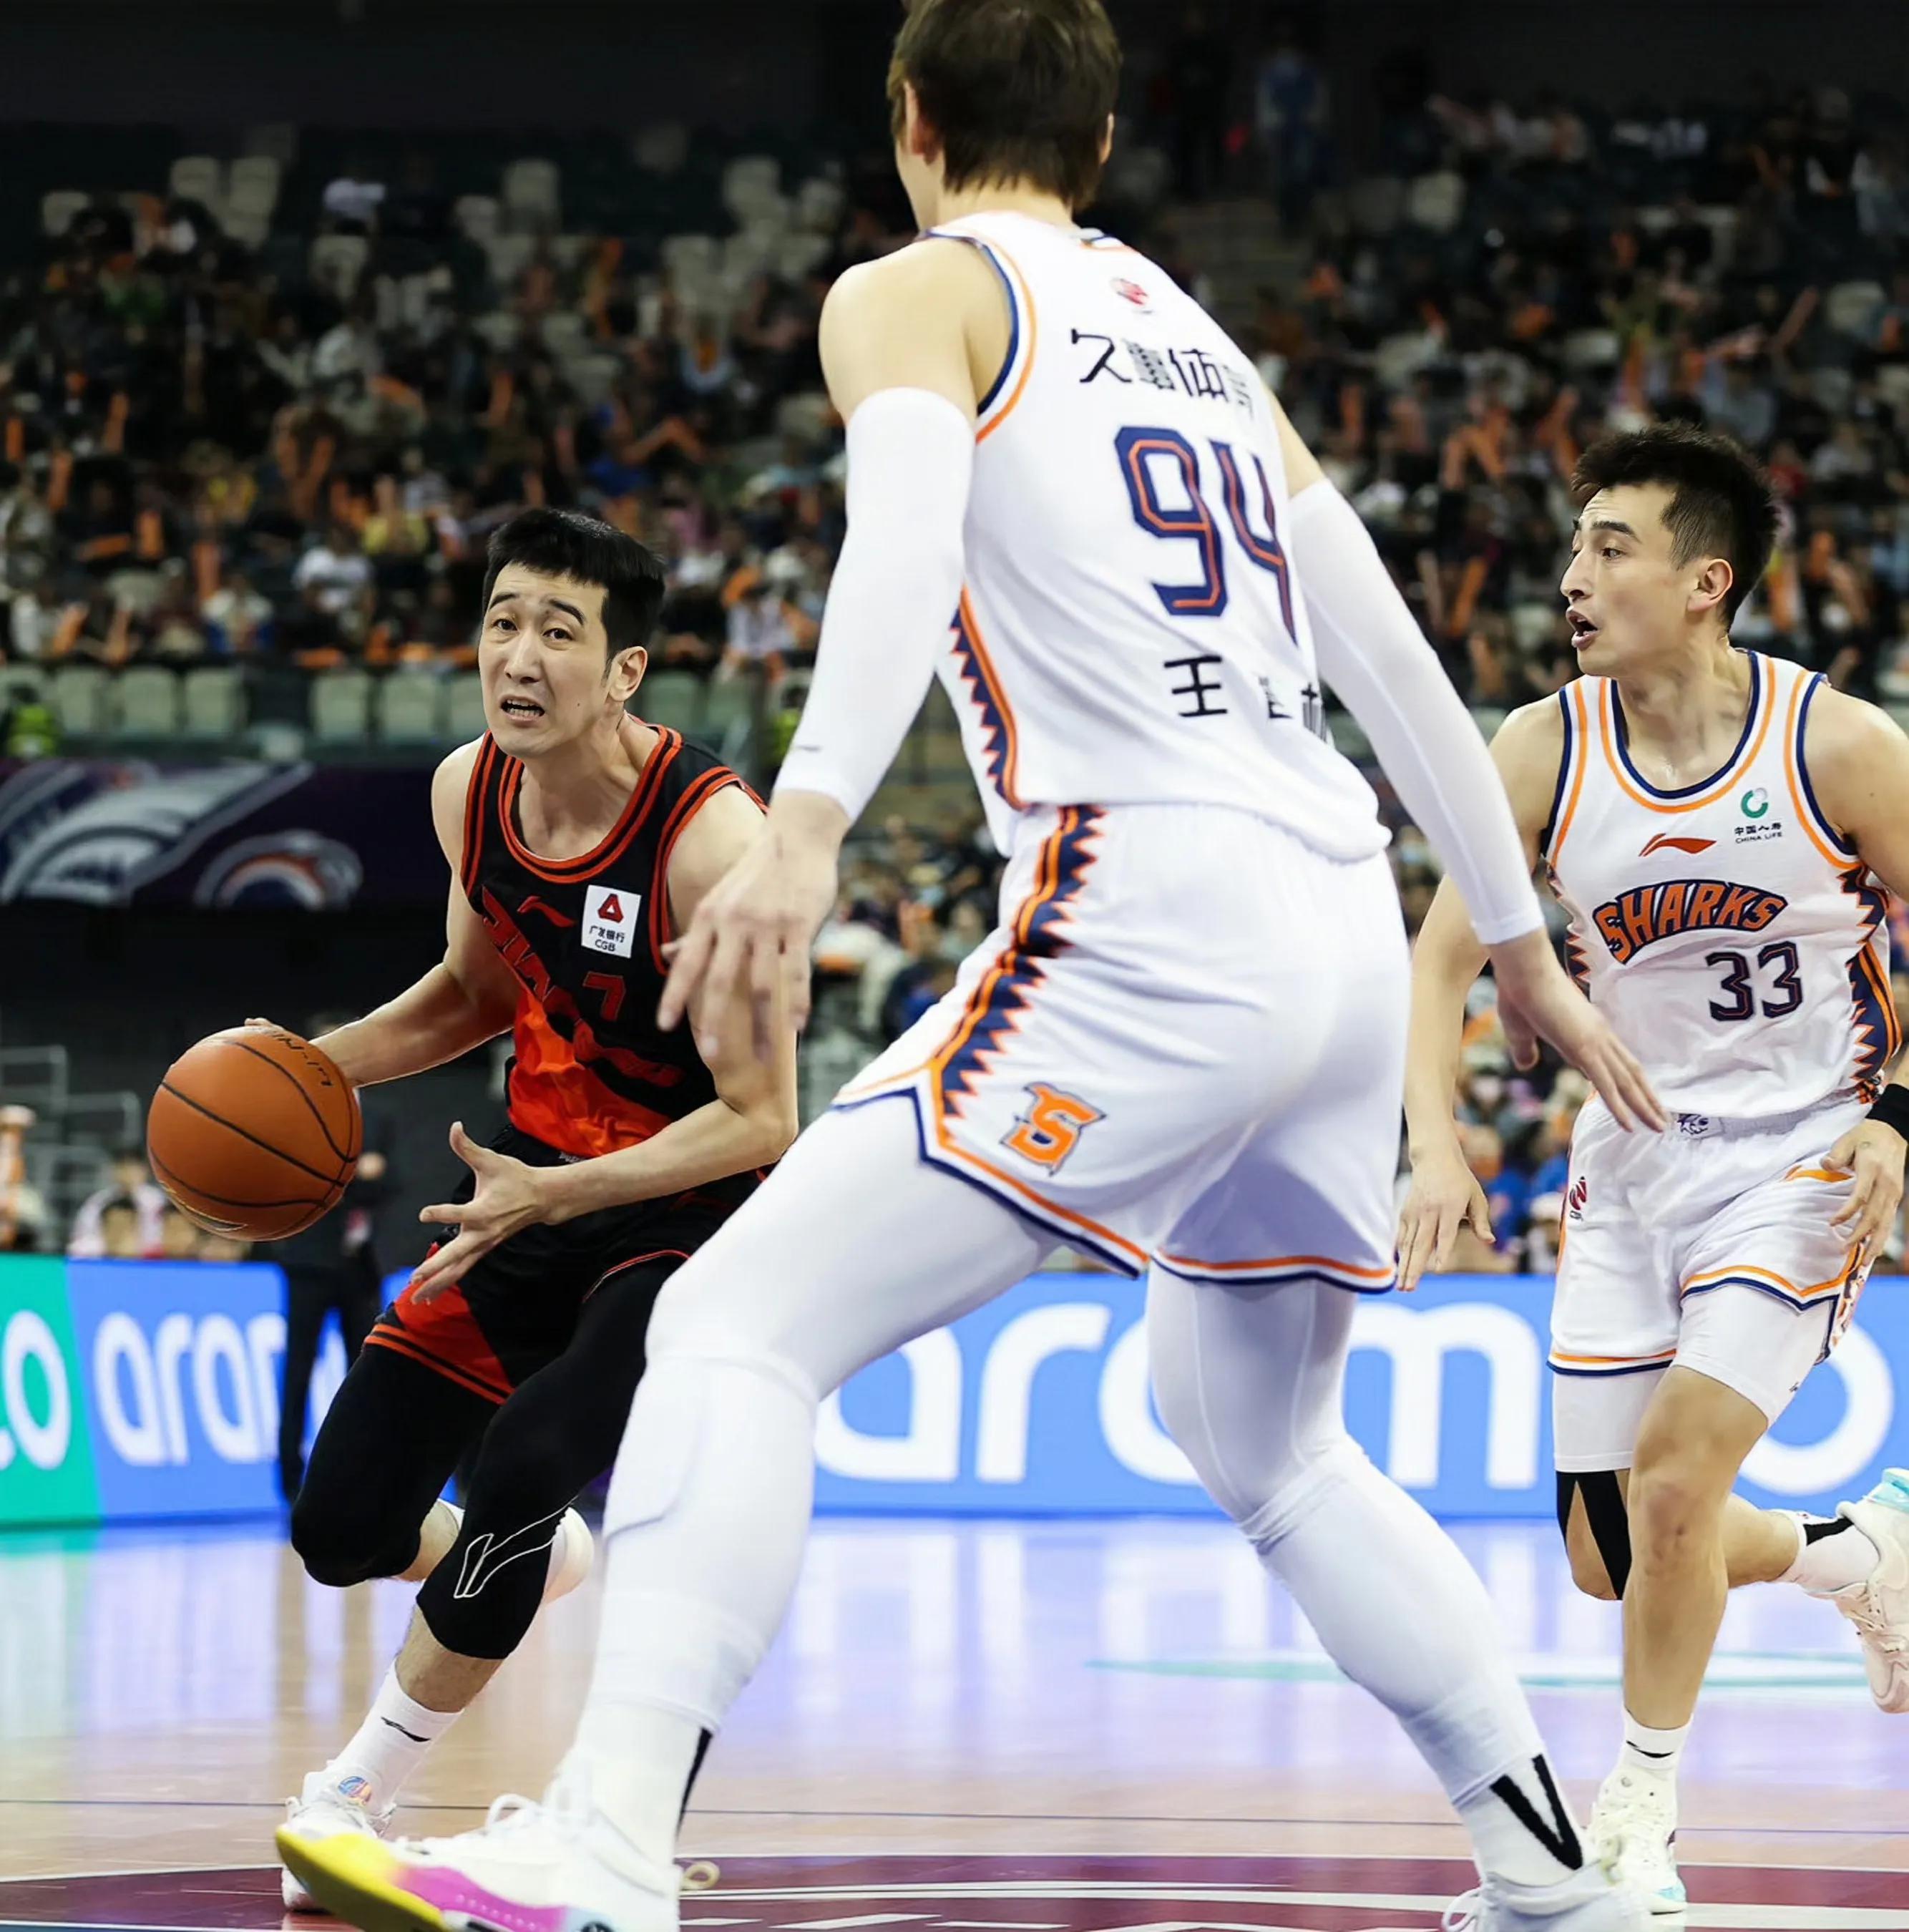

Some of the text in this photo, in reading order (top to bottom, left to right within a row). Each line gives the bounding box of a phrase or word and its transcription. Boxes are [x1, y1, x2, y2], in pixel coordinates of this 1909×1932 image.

[1114, 426, 1300, 648] 94
[595, 939, 615, 952] CGB
[1593, 879, 1788, 964] SHARKS
[582, 971, 625, 1020] 7
[1706, 941, 1802, 1021] 33
